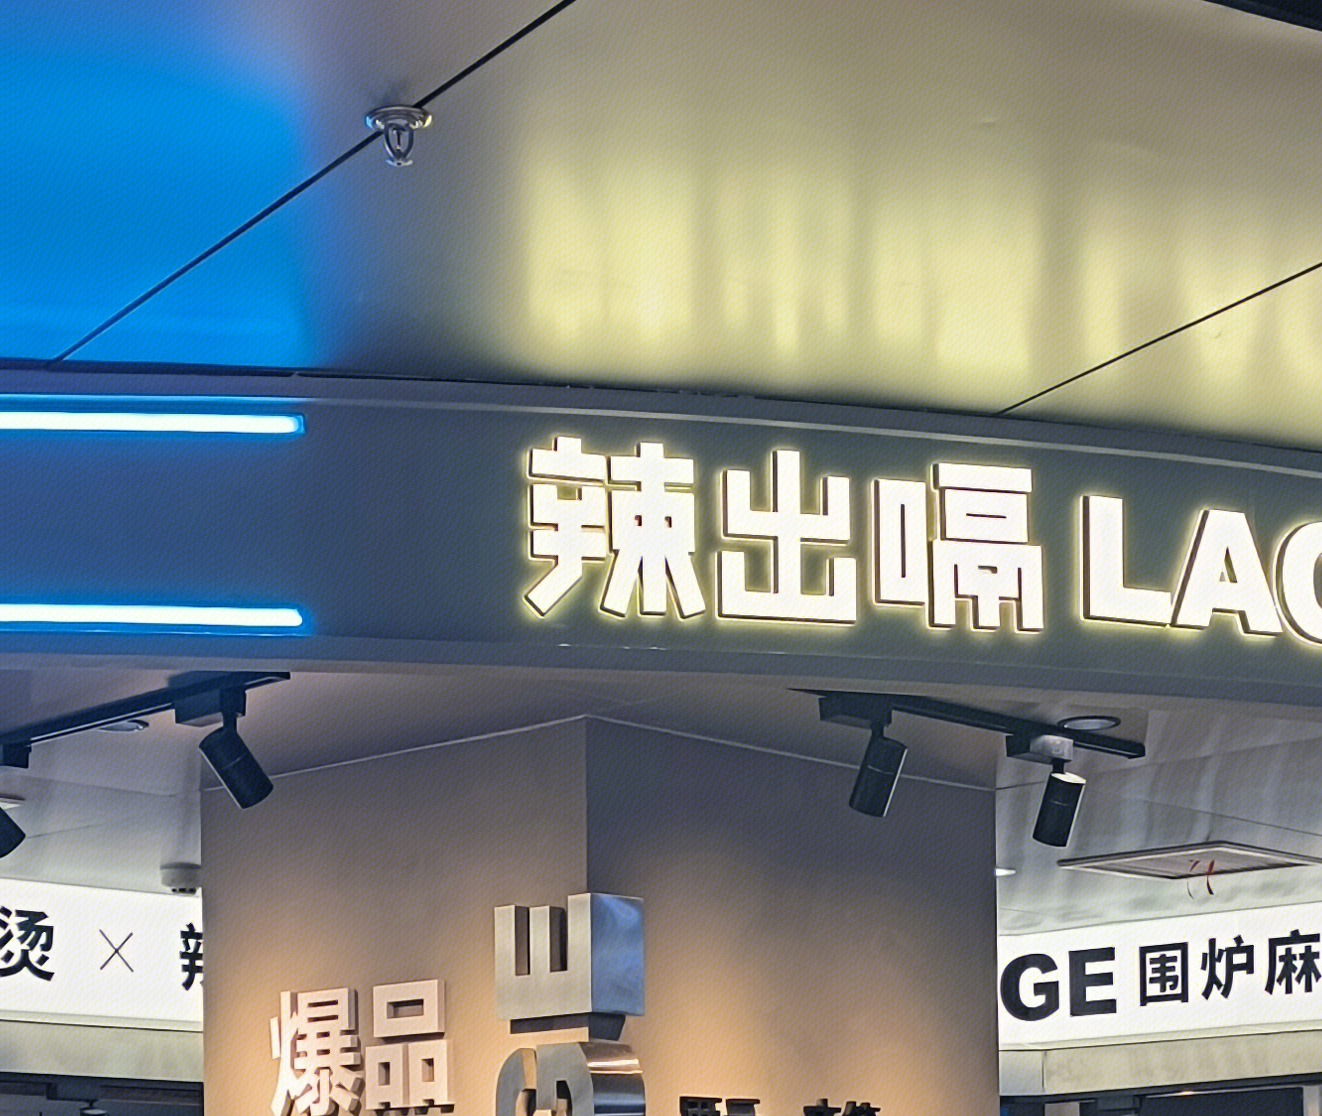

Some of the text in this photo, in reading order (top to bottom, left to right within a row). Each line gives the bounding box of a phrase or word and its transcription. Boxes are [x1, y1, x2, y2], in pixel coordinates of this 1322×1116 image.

[524, 436, 1044, 632] 辣出嗝
[1000, 946, 1118, 1022] GE
